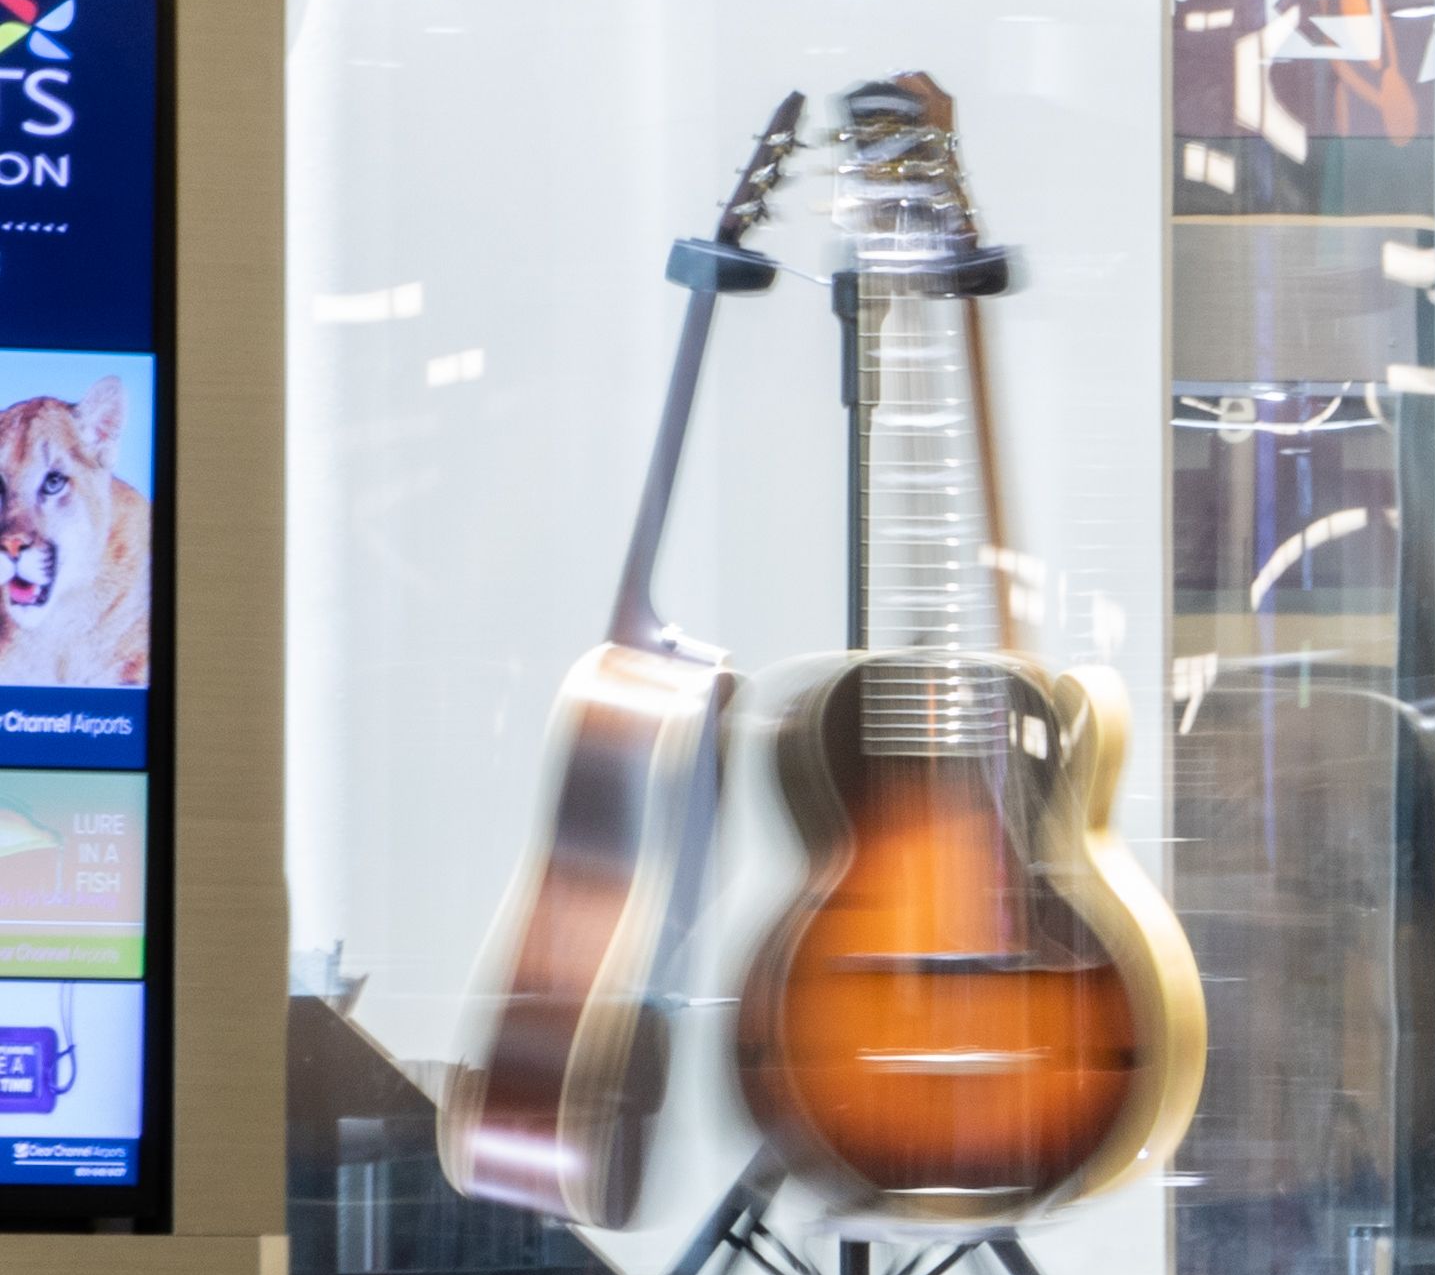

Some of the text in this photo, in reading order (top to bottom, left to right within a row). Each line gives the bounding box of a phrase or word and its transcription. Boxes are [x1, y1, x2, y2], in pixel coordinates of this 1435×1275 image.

[74, 813, 126, 836] LURE
[78, 843, 120, 864] IN A
[76, 871, 121, 893] FISH
